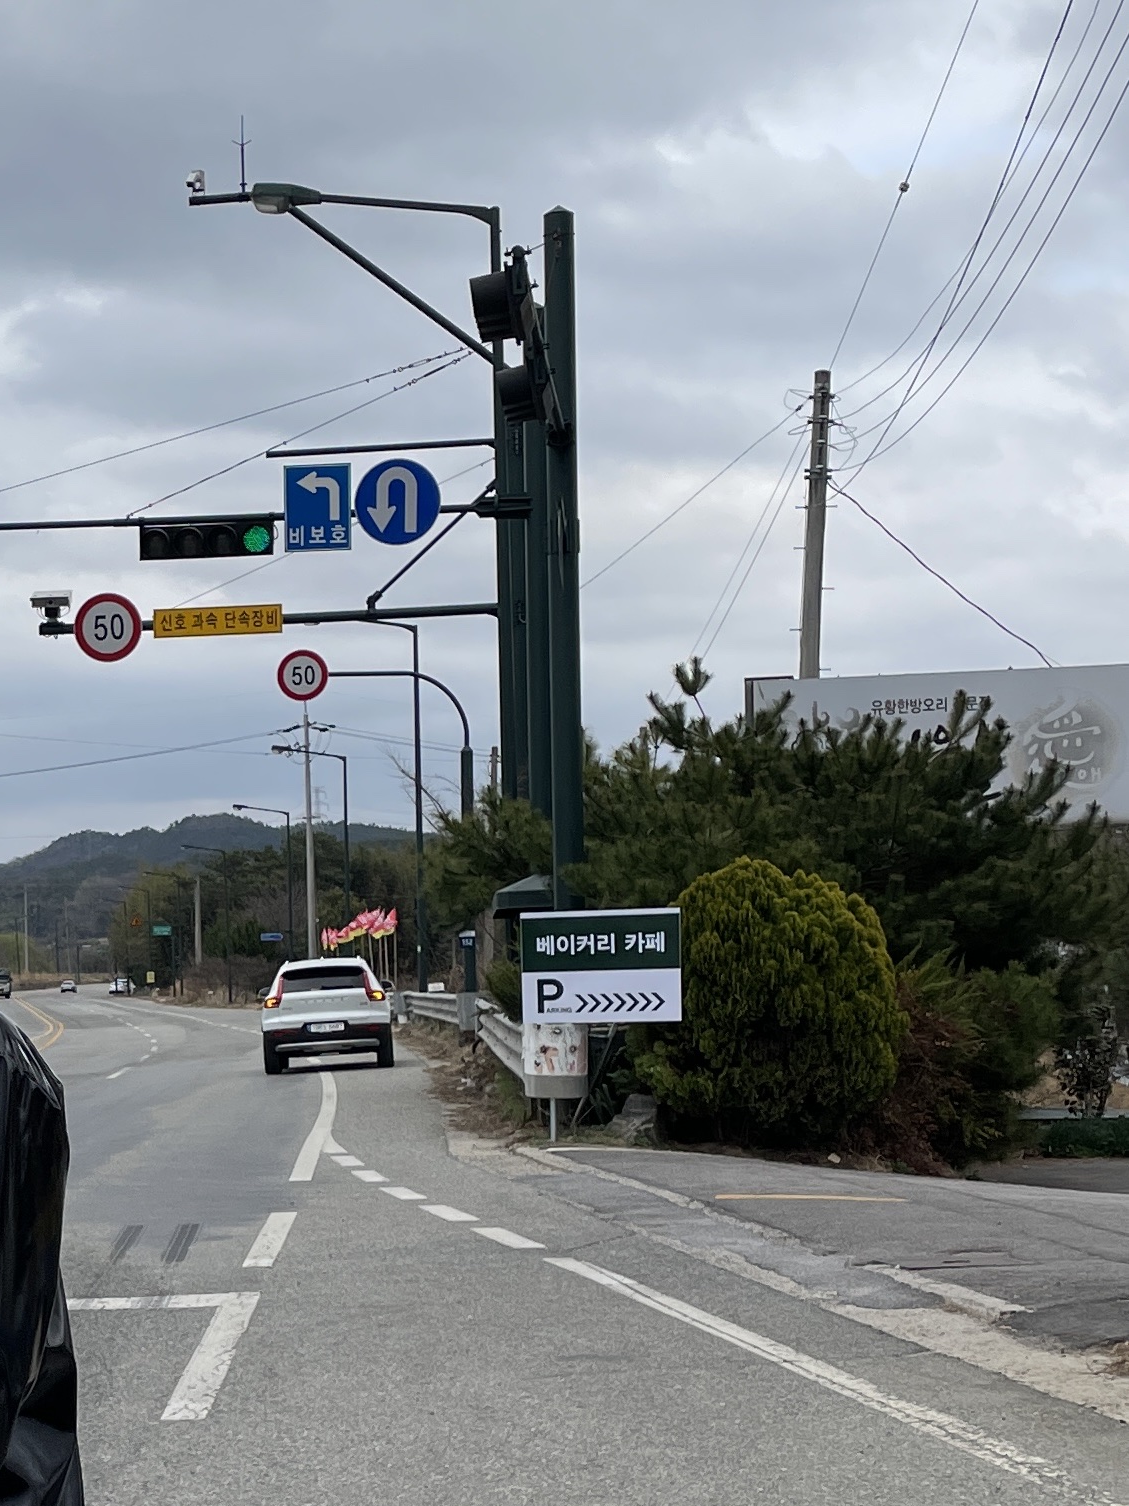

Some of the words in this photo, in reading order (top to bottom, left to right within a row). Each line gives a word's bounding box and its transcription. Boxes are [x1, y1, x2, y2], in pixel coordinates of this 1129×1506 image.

[289, 524, 347, 547] 비보호
[94, 613, 124, 641] 50
[160, 613, 187, 631] 신호
[191, 611, 218, 630] 과속
[224, 608, 278, 629] 단속장비
[292, 665, 315, 685] 50
[536, 932, 615, 956] 베이커리
[624, 931, 665, 954] 카페
